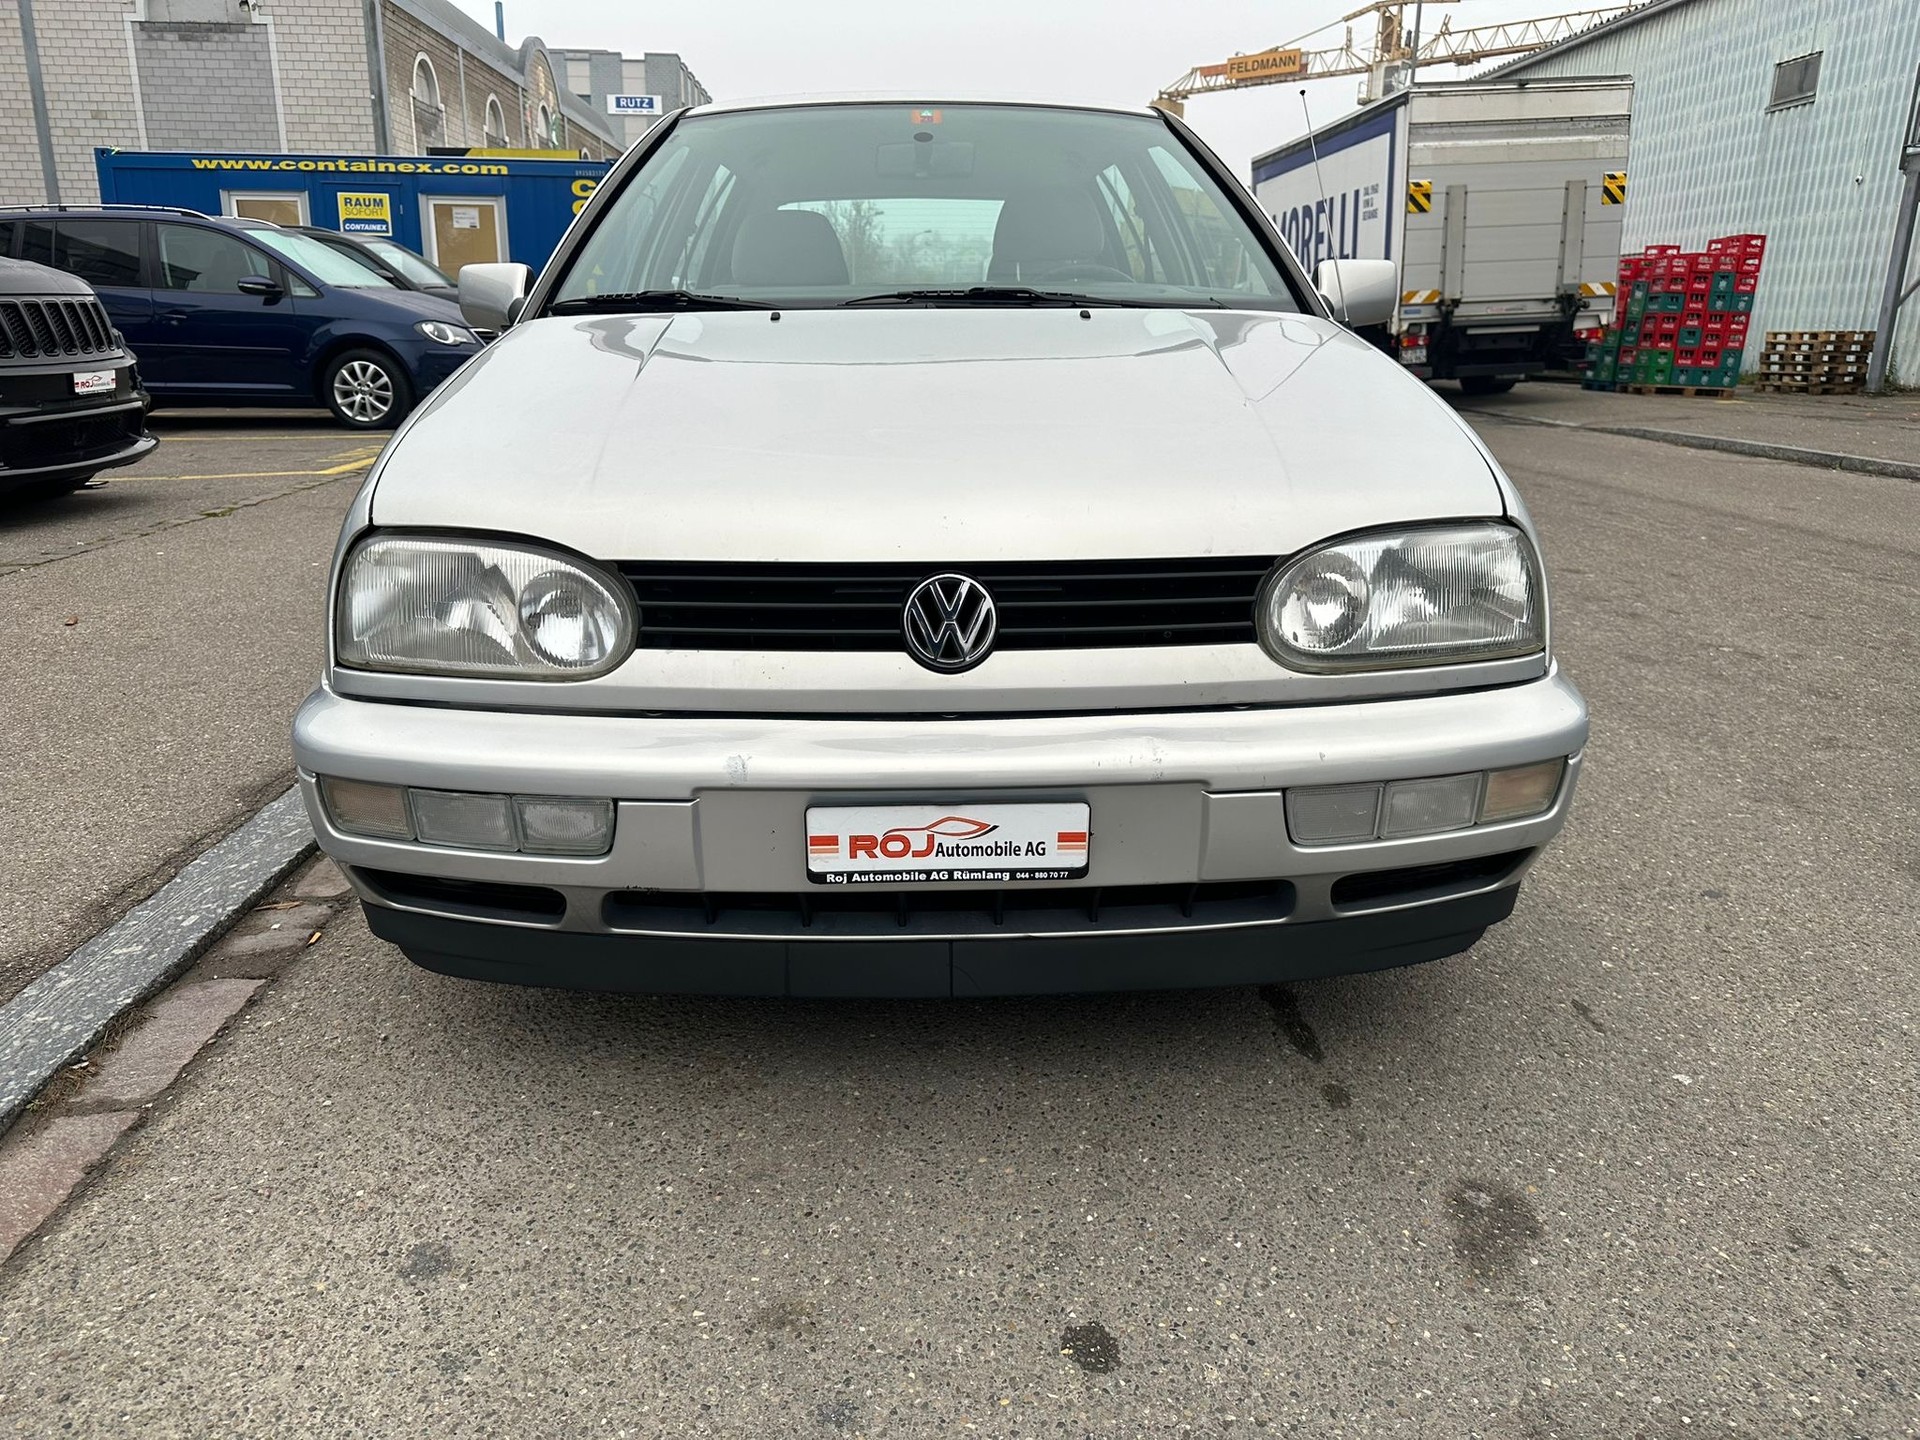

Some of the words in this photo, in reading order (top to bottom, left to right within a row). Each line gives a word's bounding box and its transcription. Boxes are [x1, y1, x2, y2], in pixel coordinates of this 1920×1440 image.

[1229, 55, 1297, 74] FELDMANN
[620, 98, 650, 108] RUTZ
[191, 159, 509, 175] www.containex.com
[344, 197, 383, 208] RAUM
[345, 206, 383, 217] SOFORT
[345, 223, 387, 231] CONTAINEX
[848, 834, 935, 859] ROJ
[935, 841, 1021, 858] Automobile
[1025, 841, 1046, 857] AG
[826, 873, 848, 884] Roj
[851, 872, 927, 882] Automobile
[929, 871, 949, 880] AG
[953, 870, 1010, 881] Rümlang
